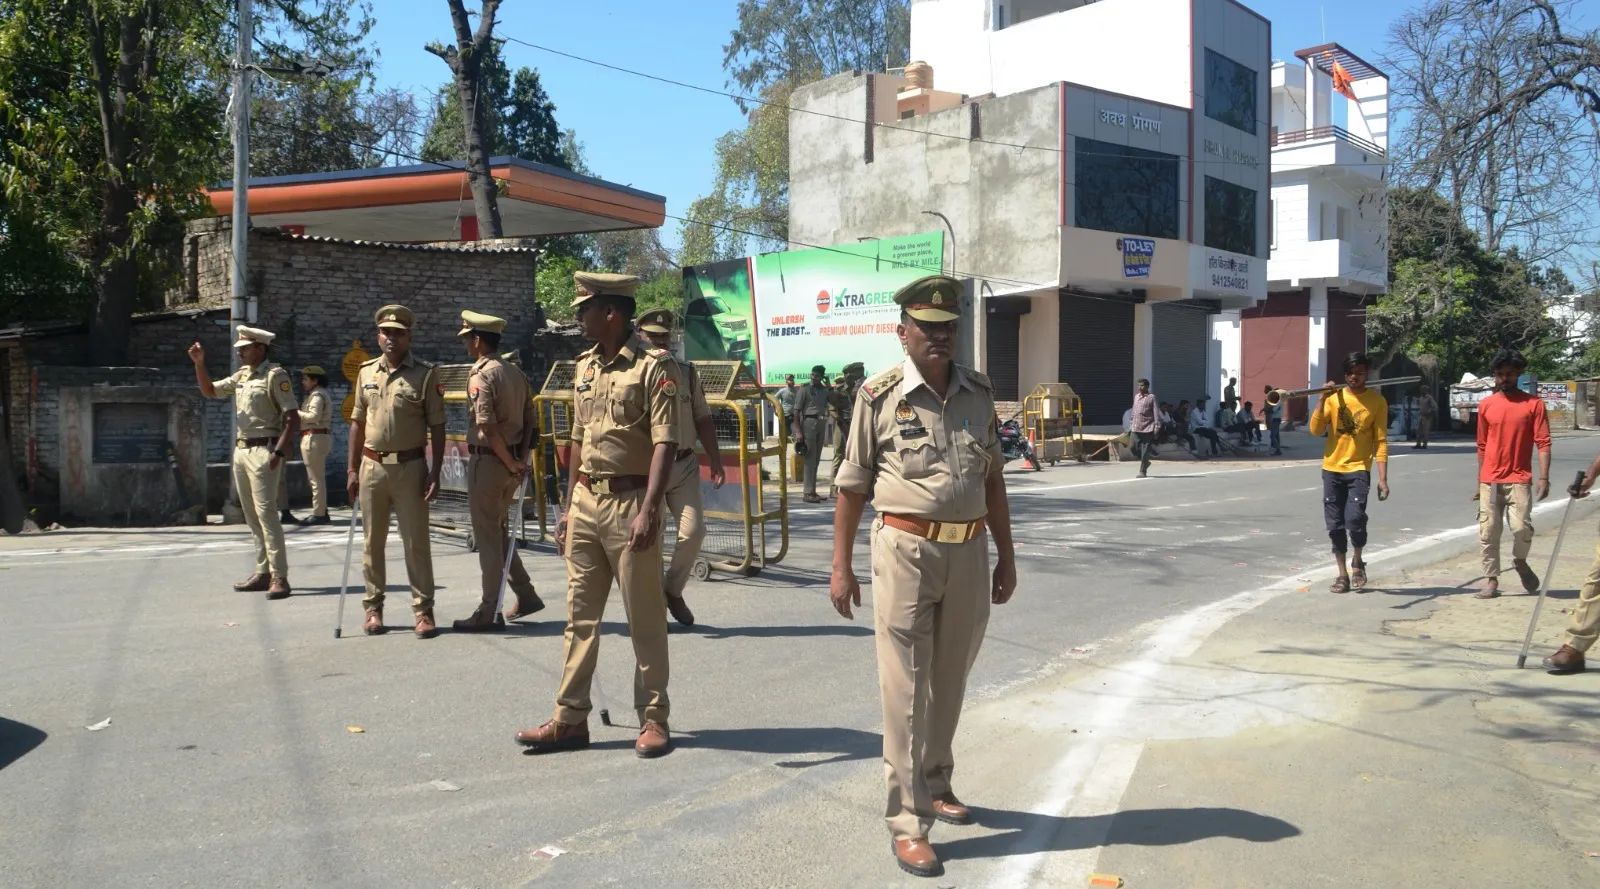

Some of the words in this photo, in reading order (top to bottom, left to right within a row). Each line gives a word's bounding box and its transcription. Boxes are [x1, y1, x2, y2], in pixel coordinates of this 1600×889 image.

[1100, 109, 1126, 128] अवध
[1132, 112, 1162, 134] प्रांगण
[897, 251, 917, 260] greener
[892, 260, 908, 269] MILE
[910, 259, 920, 267] BY
[835, 288, 897, 308] XTRAGREE
[771, 315, 805, 326] UNLEASH
[766, 328, 780, 337] THE
[819, 326, 848, 337] PREMIUM
[849, 324, 875, 335] QUALITY
